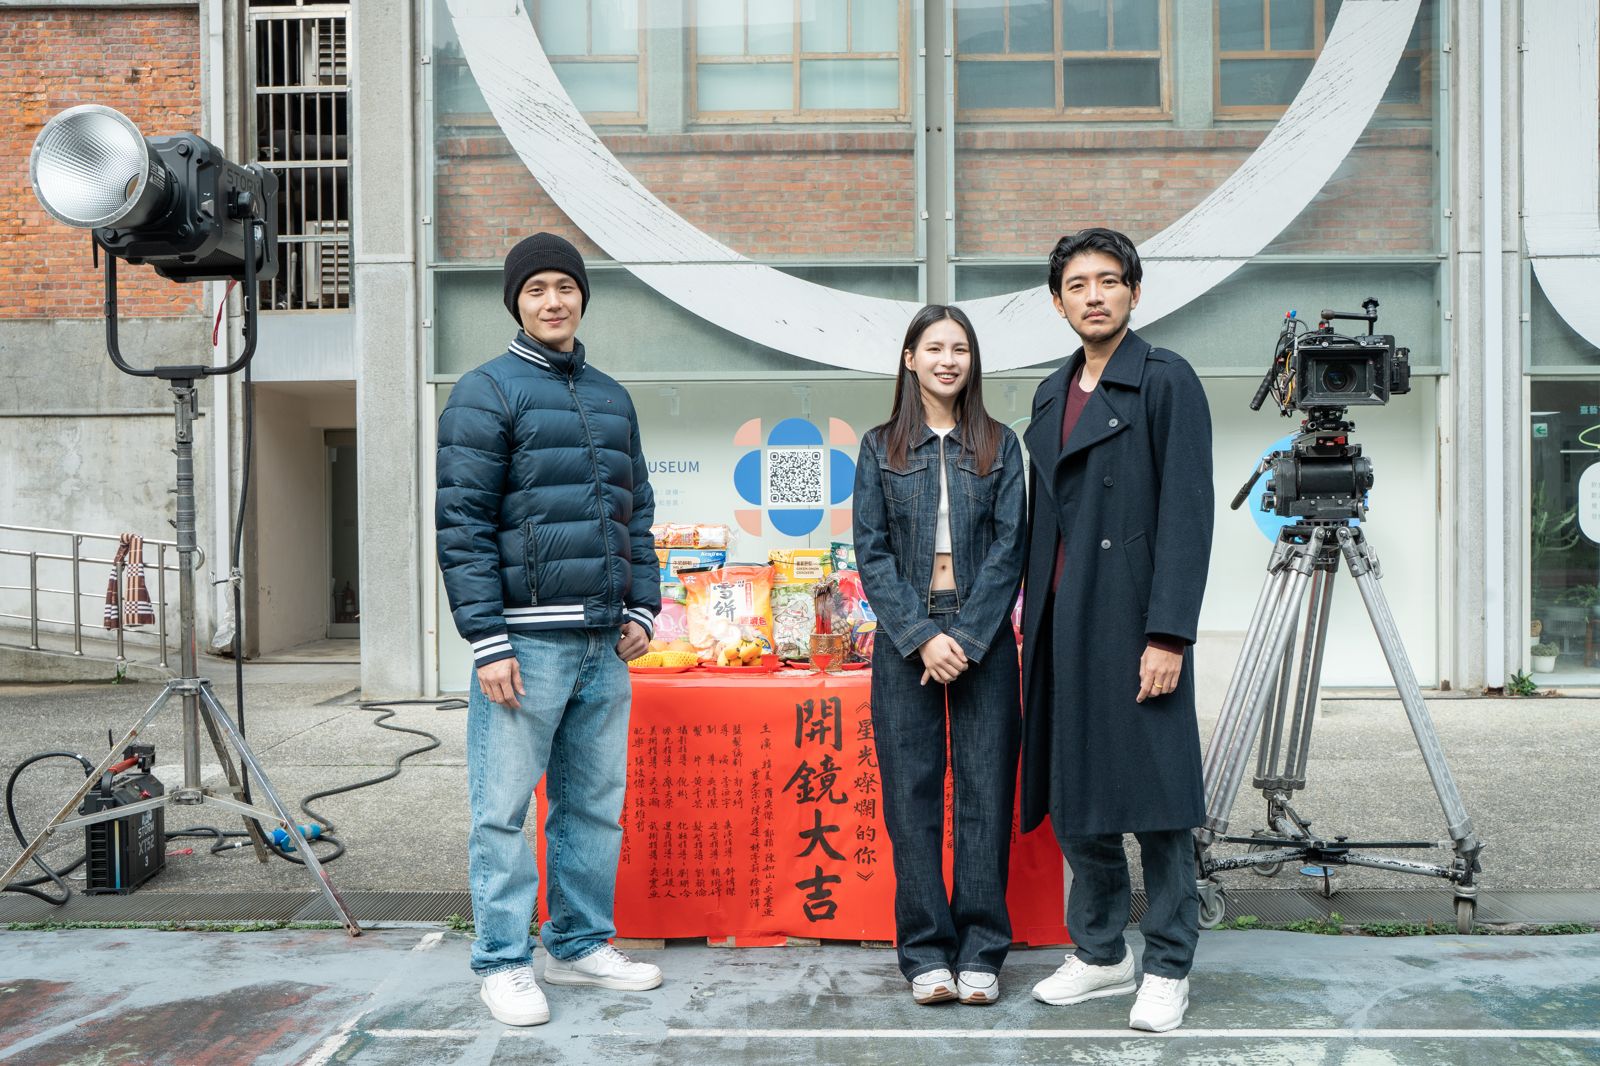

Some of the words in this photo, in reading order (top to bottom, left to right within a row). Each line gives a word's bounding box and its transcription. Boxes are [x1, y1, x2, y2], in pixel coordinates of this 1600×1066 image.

[648, 461, 699, 473] USEUM
[781, 695, 849, 923] 開鏡大吉
